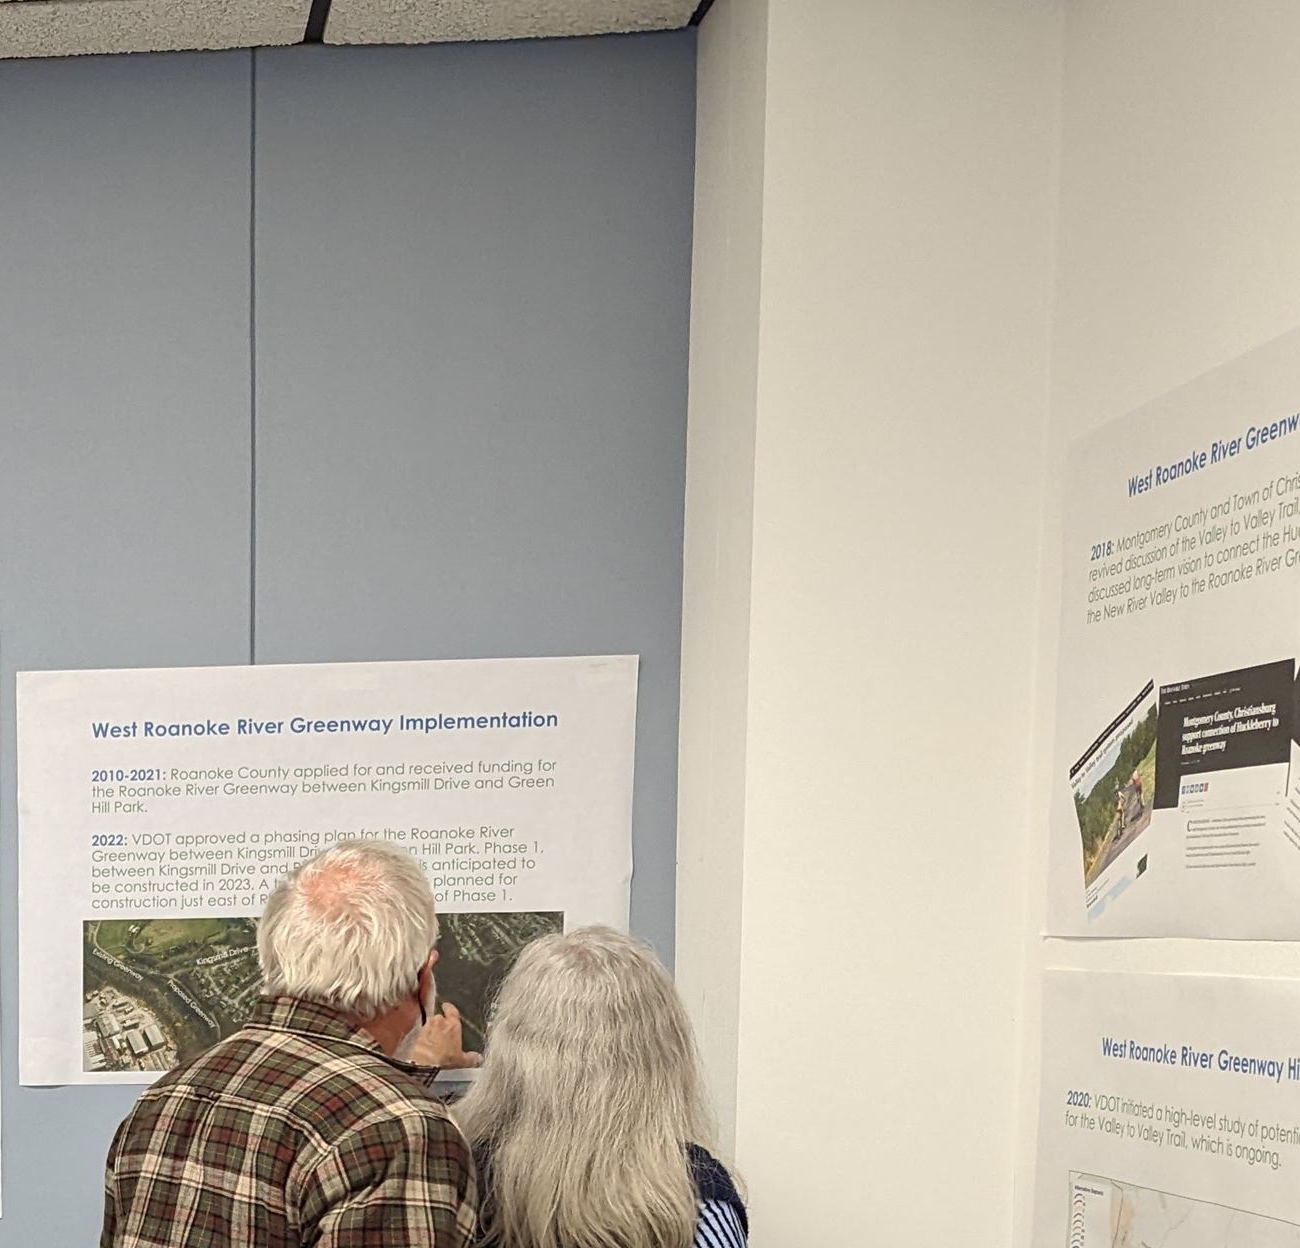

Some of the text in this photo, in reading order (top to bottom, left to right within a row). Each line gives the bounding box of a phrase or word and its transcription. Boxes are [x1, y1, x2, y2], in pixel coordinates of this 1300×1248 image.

[1128, 412, 1300, 497] West Roanoke River Greenw
[1091, 540, 1114, 561] 2018:
[1116, 523, 1173, 553] Montgomery
[1174, 507, 1208, 532] County
[1210, 499, 1230, 520] and
[1233, 490, 1259, 512] Town
[1262, 479, 1274, 500] of
[1234, 703, 1276, 715] Christiansburg
[92, 712, 558, 738] West Roanoke River Greenway Implementation
[92, 759, 557, 782] 2010-2021: Roanoke County applied for and received funding for
[92, 776, 554, 798] the Roanoke River Greenway between Kingsmill Drive and Green
[92, 801, 148, 813] Hill Park.
[92, 826, 514, 847] 2022: VDOT approved a phasing plan for the Roanoke River
[92, 850, 165, 863] Greenway
[169, 849, 232, 860] between
[237, 847, 295, 861] Kingsmill
[299, 846, 324, 858] Dri
[423, 843, 440, 855] Hill
[445, 843, 479, 854] Park.
[484, 841, 527, 853] Phase
[92, 865, 155, 878] between
[159, 864, 216, 878] Kingsmill
[221, 863, 255, 875] Drive
[260, 862, 288, 874] and
[420, 860, 427, 871] is
[432, 858, 516, 872] anticipated
[522, 858, 535, 869] to
[92, 881, 110, 893] be
[115, 879, 198, 893] constructed
[203, 879, 214, 891] in
[219, 879, 253, 891] 2023.
[259, 879, 269, 889] A
[434, 874, 494, 888] planned
[499, 874, 518, 885] for
[92, 895, 177, 909] construction
[181, 895, 203, 910] just
[207, 895, 237, 906] east
[242, 894, 256, 906] of
[435, 891, 448, 902] of
[453, 890, 496, 902] Phase
[502, 889, 513, 901] 1.
[1102, 1037, 1127, 1058] West
[1129, 1040, 1177, 1065] Roanoke
[1180, 1046, 1214, 1069] River
[1218, 1050, 1284, 1083] Greenway
[1067, 1090, 1092, 1109] 2020:
[1094, 1095, 1120, 1113] VDOT
[1121, 1098, 1153, 1119] initiated
[1156, 1107, 1162, 1120] a
[1165, 1105, 1216, 1129] high-level
[1218, 1116, 1246, 1138] study
[1248, 1121, 1258, 1137] of
[1065, 1111, 1282, 1170] for the Valley to Valley Trail, which is ongoing.
